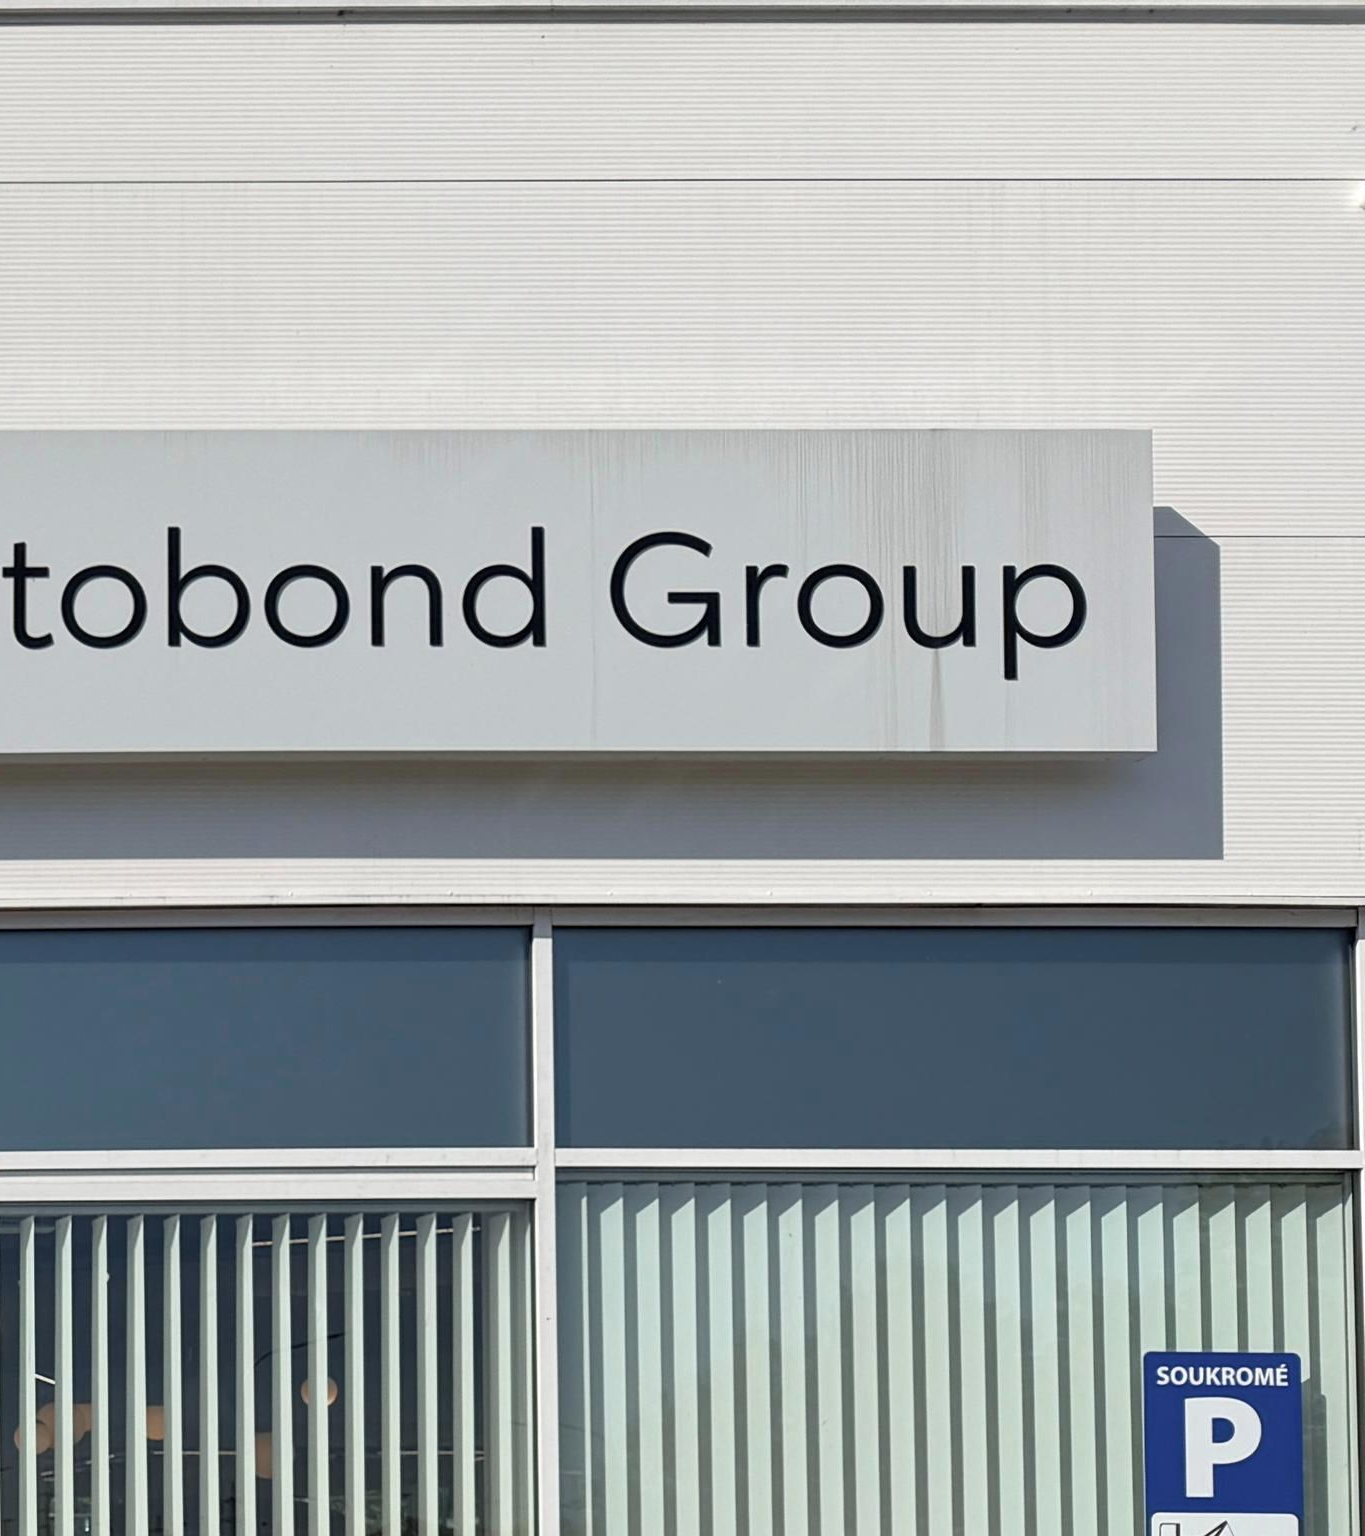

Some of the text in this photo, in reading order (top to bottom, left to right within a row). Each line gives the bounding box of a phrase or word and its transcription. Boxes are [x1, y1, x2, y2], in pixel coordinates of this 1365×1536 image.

[607, 530, 1089, 681] Group
[1156, 1364, 1289, 1387] SOUKROMÉ
[1184, 1396, 1262, 1498] P
